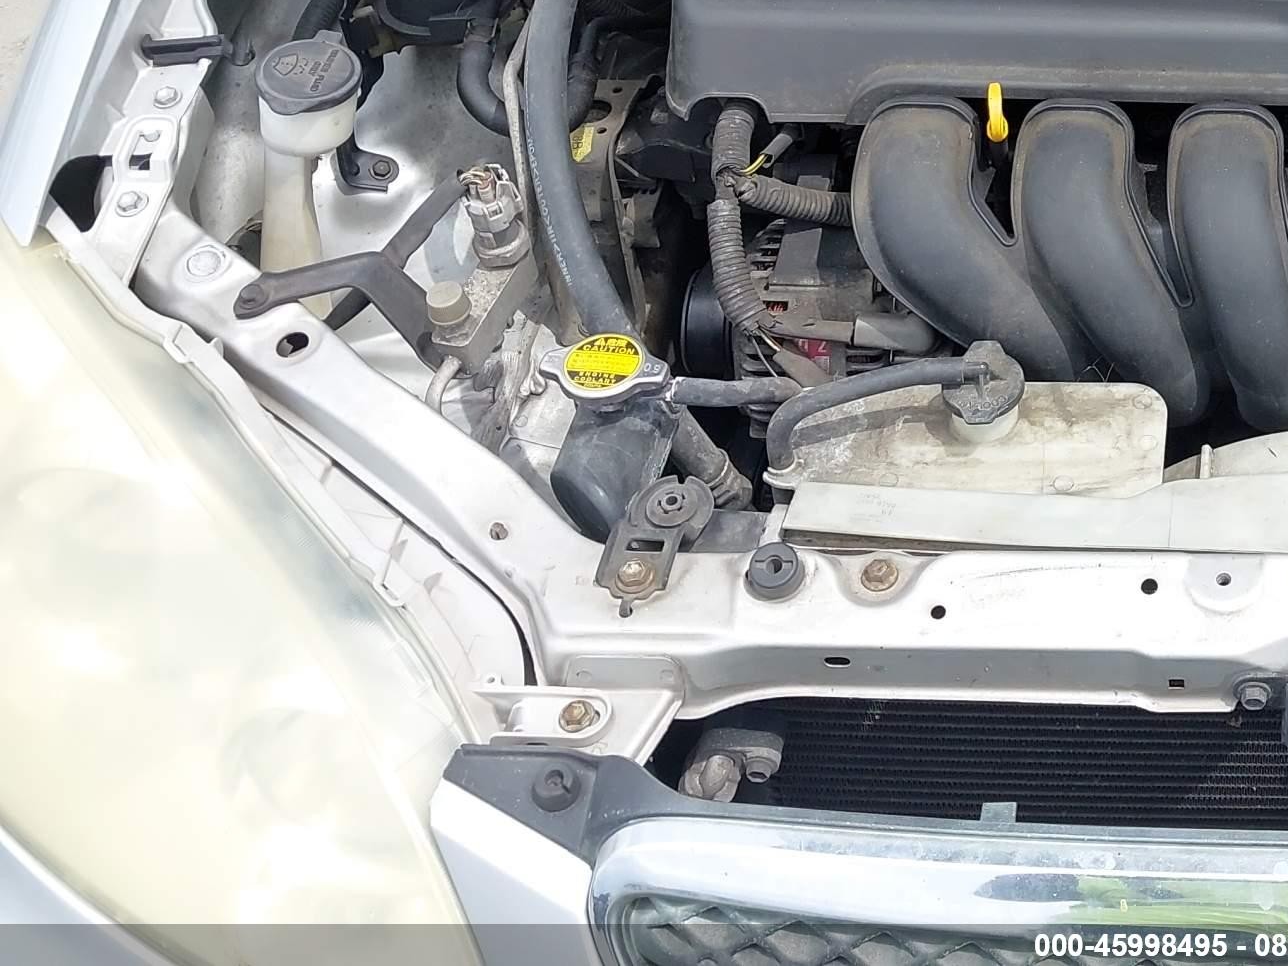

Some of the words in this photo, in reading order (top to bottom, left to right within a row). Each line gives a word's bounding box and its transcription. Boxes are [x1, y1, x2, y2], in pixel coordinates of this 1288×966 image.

[582, 344, 636, 355] CAUTION
[578, 370, 616, 379] ENGINE
[573, 376, 617, 386] COOLANT
